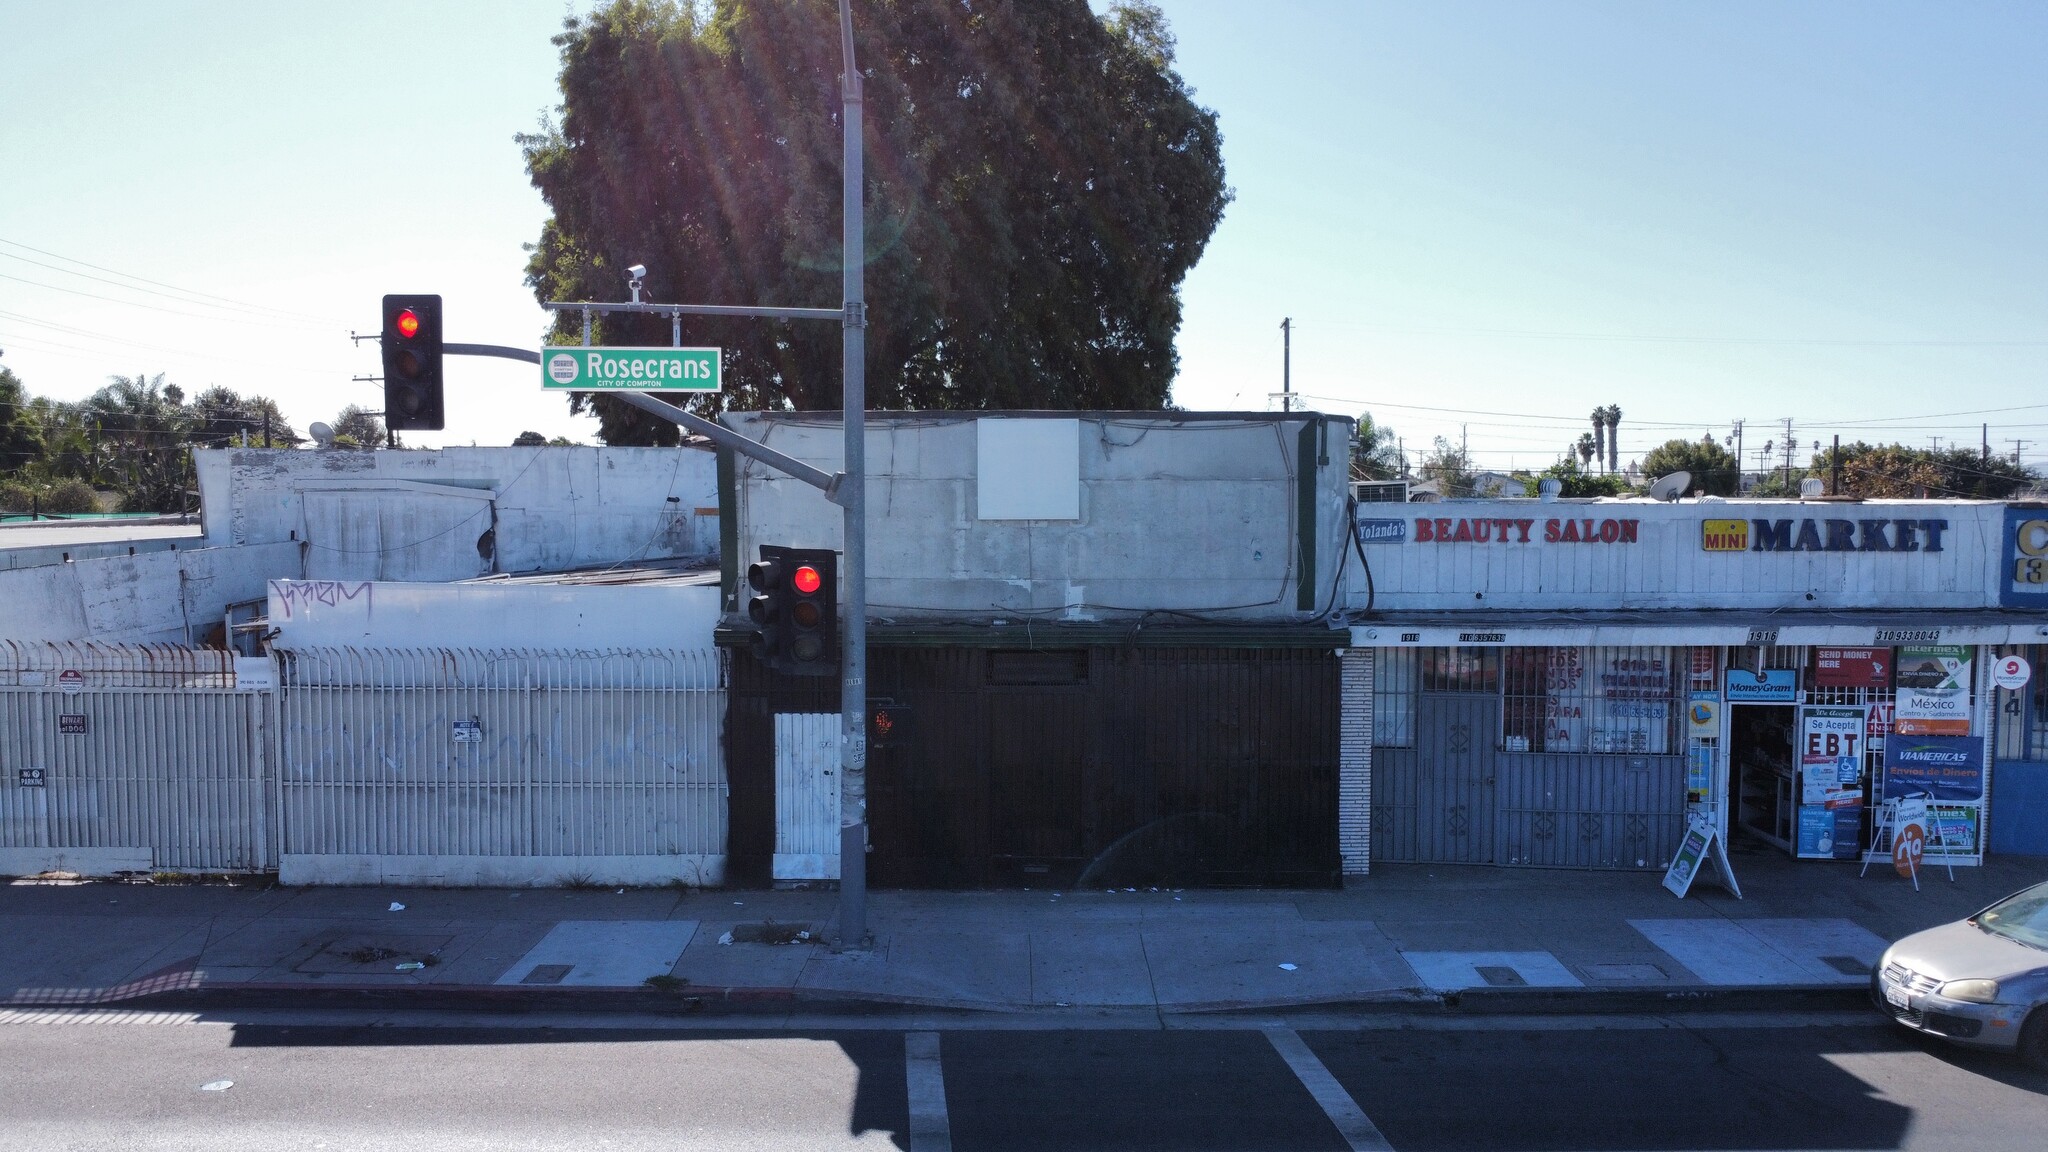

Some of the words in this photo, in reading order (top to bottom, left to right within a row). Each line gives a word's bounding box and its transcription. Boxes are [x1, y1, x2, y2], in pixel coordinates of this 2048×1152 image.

[587, 353, 711, 379] Rosecrans
[1360, 523, 1405, 540] Yolanda's
[1414, 518, 1535, 543] BEAUTY
[1544, 518, 1640, 543] SALON
[1751, 518, 1949, 552] MARKET
[1705, 533, 1747, 549] MINI
[1750, 631, 1777, 640] 1916
[1819, 651, 1841, 659] SEND
[1843, 651, 1872, 659] MONEY
[1819, 660, 1840, 668] HERE
[1730, 683, 1791, 694] MoneyGram
[1911, 698, 1955, 709] México
[61, 716, 84, 724] BEWARE
[1812, 719, 1823, 729] Se
[1826, 720, 1855, 731] Acepta
[1809, 732, 1858, 756] EBT
[1900, 751, 1967, 762] VIAMERICAS
[1927, 768, 1939, 776] de
[1943, 768, 1978, 777] Dinero
[1897, 832, 1922, 860] ria
